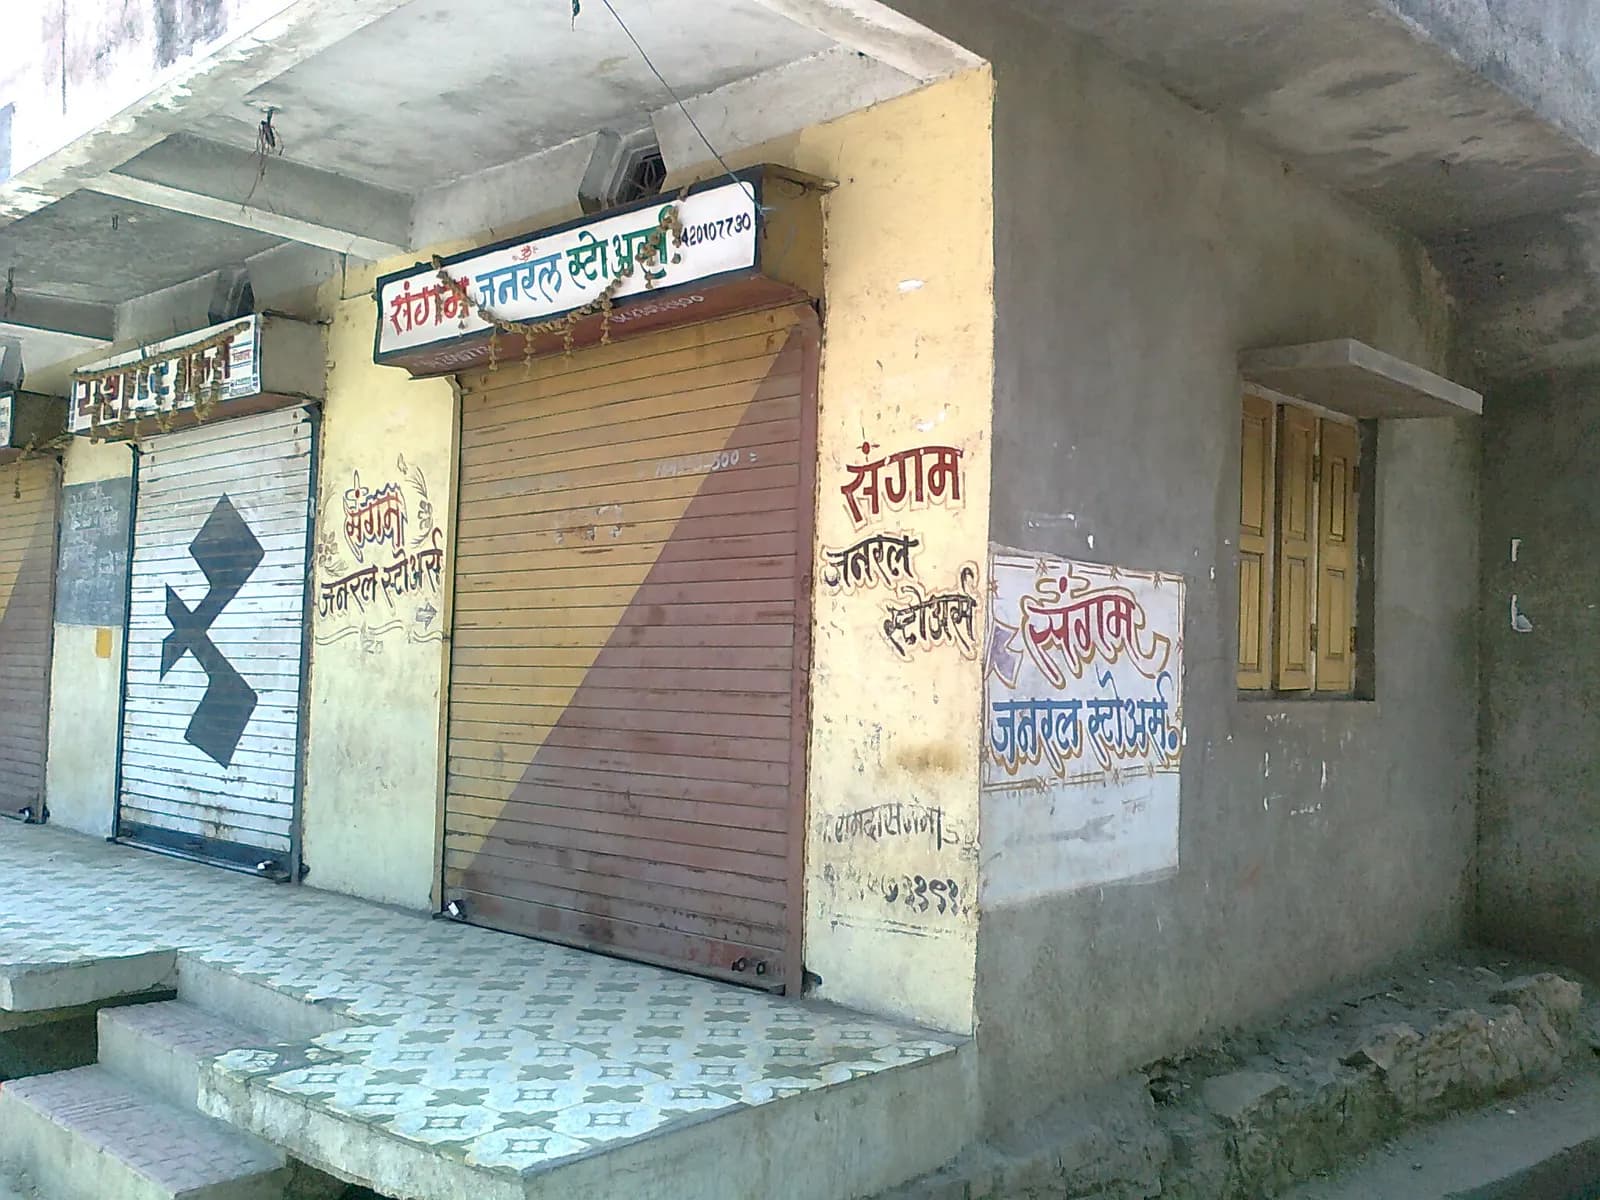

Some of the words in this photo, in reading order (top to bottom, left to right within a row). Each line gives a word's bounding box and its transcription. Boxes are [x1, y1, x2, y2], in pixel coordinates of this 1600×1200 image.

[390, 276, 470, 336] संगम
[475, 253, 562, 308] जनरल
[841, 441, 963, 523] संगम
[318, 565, 378, 617] जनरल
[824, 535, 919, 587] जनरल
[1028, 577, 1140, 682] संगम
[991, 697, 1083, 770] जनरल
